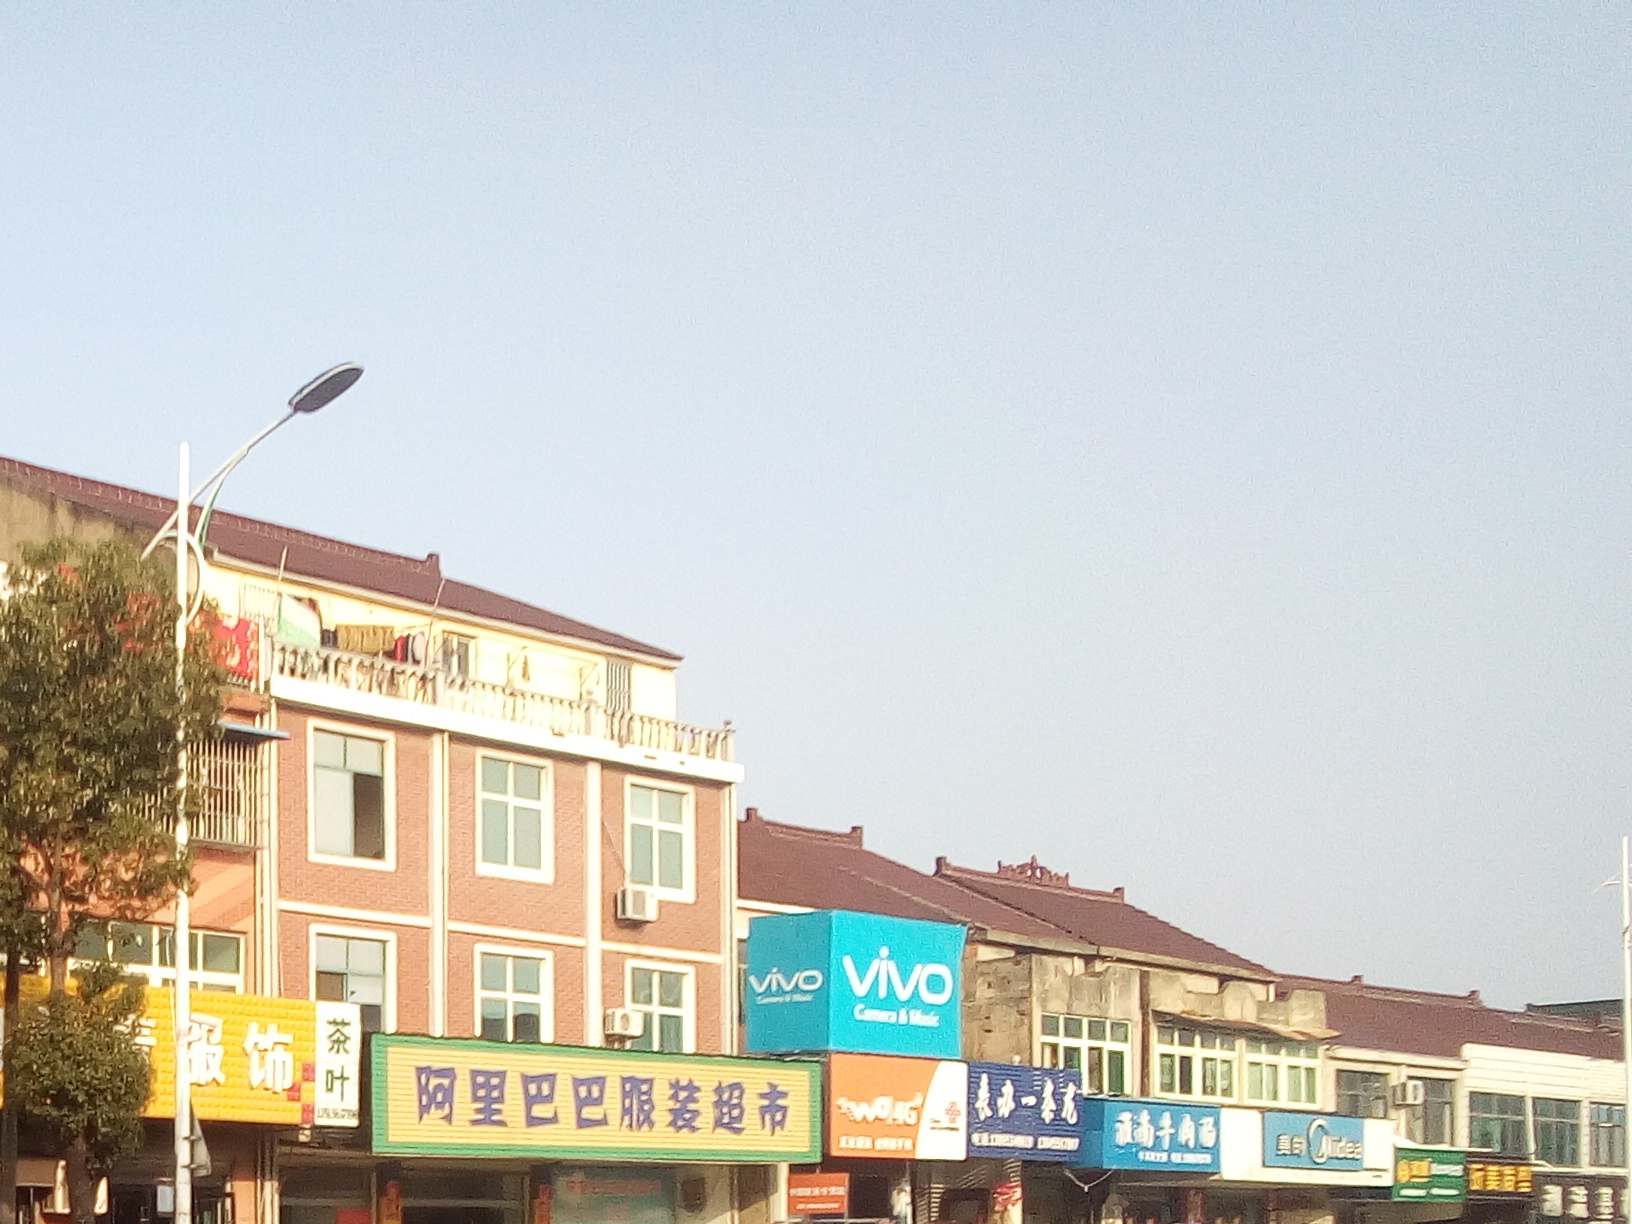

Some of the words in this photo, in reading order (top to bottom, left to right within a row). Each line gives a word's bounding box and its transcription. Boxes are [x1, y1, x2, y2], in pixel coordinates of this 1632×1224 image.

[325, 1017, 351, 1102] 茶叶
[414, 1065, 790, 1137] 阿里巴巴服装超市
